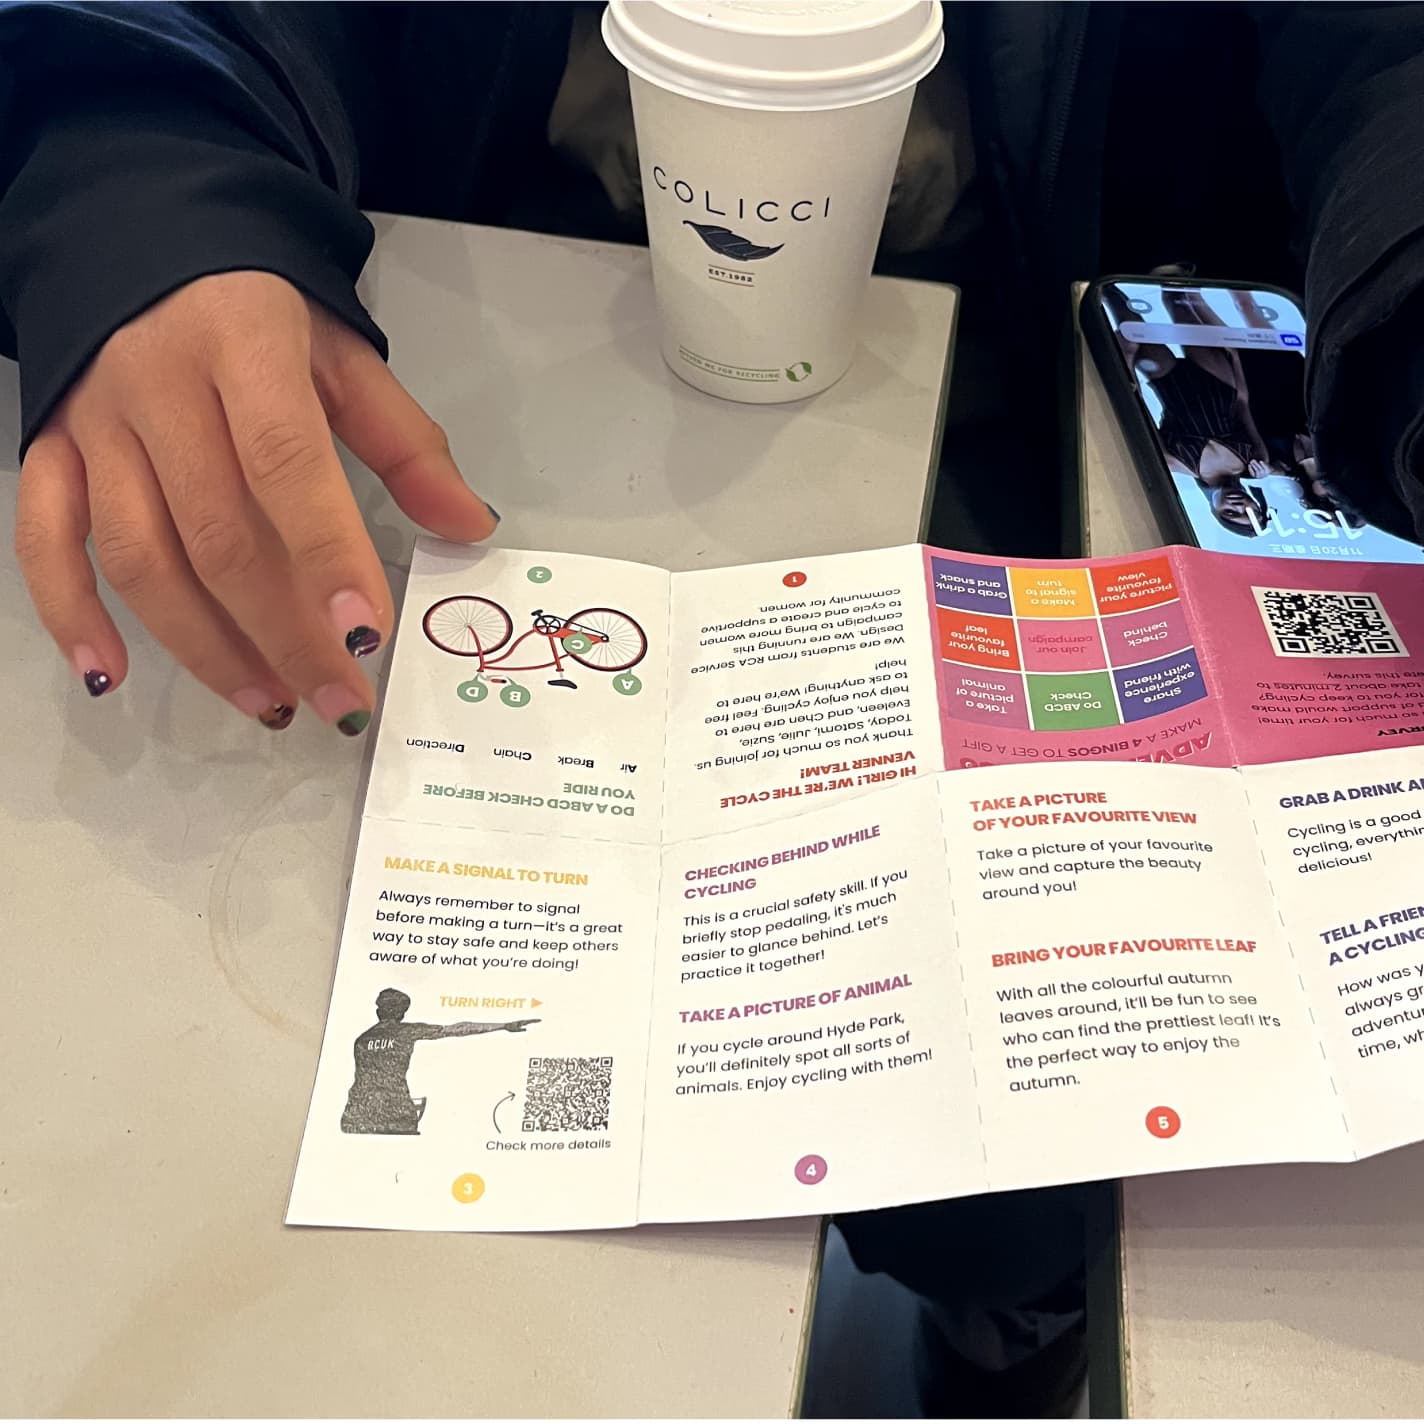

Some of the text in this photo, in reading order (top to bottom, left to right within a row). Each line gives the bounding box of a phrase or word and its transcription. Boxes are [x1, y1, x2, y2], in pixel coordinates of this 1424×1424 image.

[653, 166, 830, 221] COLICCI
[1246, 507, 1363, 539] 15:11
[936, 582, 965, 592] drink
[940, 574, 975, 584] snack
[978, 590, 1007, 598] Grab
[571, 640, 584, 650] C
[466, 687, 479, 697] D
[621, 680, 635, 690] A
[509, 691, 521, 702] B
[1051, 692, 1092, 701] Check
[406, 738, 464, 752] Direction
[494, 748, 532, 760] Chain
[558, 756, 594, 768] Break
[620, 764, 637, 773] Air
[800, 751, 915, 778] VENNER TEAM!
[858, 770, 898, 786] GIRL!
[900, 766, 916, 777] HI
[423, 784, 634, 816] DO A ABCD CHECK BEFORE
[563, 783, 635, 800] YOU RIDE
[720, 791, 770, 808] CYCLE
[773, 786, 802, 799] THE
[1280, 792, 1330, 808] GRAB
[1334, 790, 1346, 802] A
[1348, 781, 1405, 800] DRINK
[970, 792, 1107, 812] TAKE A PICTURE
[974, 811, 1197, 831] OF YOUR FAVOURITE VIEW
[685, 825, 880, 881] CHECKING BEHIND WHILE
[977, 839, 1212, 860] Take a picture of your favourite
[384, 856, 588, 886] MAKE A SIGNAL TO TURN
[979, 858, 1201, 880] view and capture the beauty
[684, 878, 756, 899] CYCLING
[983, 880, 1076, 900] around you!
[379, 890, 580, 916] Always remember to signal
[684, 870, 907, 926] This is a crucial safety skill. If you
[376, 909, 424, 924] before
[429, 916, 484, 931] making
[570, 924, 578, 932] a
[584, 924, 622, 936] great
[683, 930, 726, 944] briefly
[731, 926, 761, 938] stop
[766, 912, 830, 935] pedaling,
[856, 892, 896, 911] much
[1320, 924, 1361, 944] TELL
[1364, 919, 1378, 932] A
[373, 932, 618, 953] way to stay safe and keep others
[682, 949, 726, 962] easier
[730, 947, 744, 956] to
[748, 938, 798, 957] glance
[802, 923, 854, 944] behind.
[992, 938, 1256, 967] BRING YOUR FAVOURITE LEAF
[1330, 952, 1343, 966] A
[369, 952, 417, 963] aware
[422, 953, 436, 964] of
[440, 954, 477, 966] what
[532, 958, 578, 972] doing!
[681, 950, 824, 984] practice it together!
[440, 996, 526, 1008] TURN RIGHT
[679, 974, 912, 1023] TAKE A PICTURE OF ANIMAL
[368, 1039, 394, 1050] RCUK
[1158, 1117, 1169, 1129] 5
[486, 1139, 611, 1150] Check more details
[806, 1164, 817, 1176] 4
[464, 1182, 472, 1194] 3
